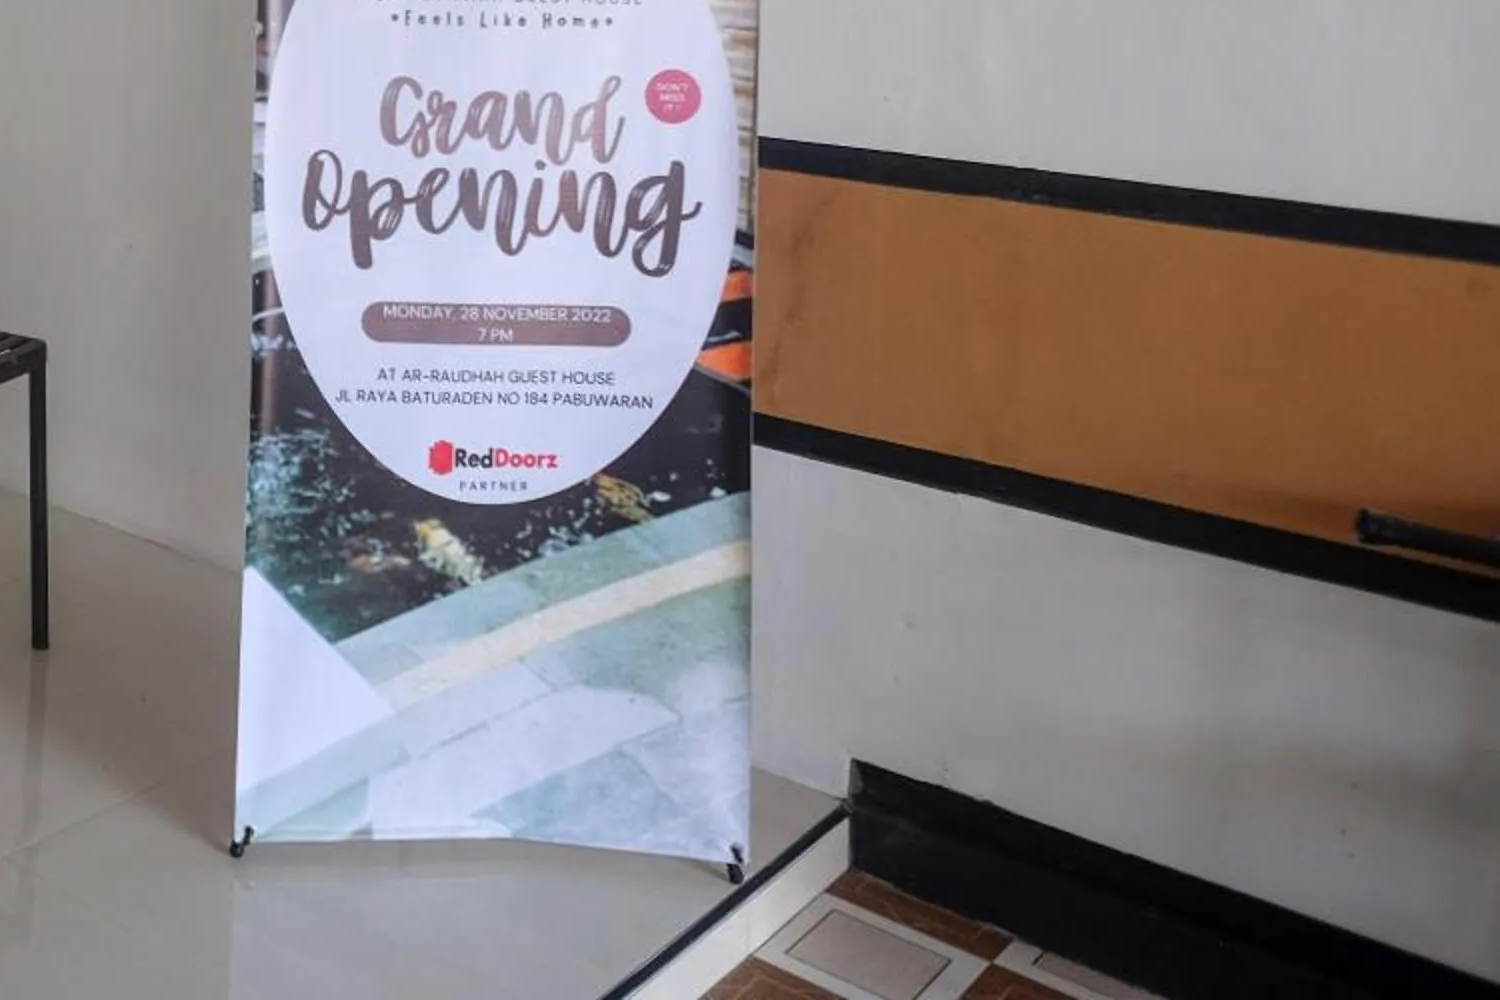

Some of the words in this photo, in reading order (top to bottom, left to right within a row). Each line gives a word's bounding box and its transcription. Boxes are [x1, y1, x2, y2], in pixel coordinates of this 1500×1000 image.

[479, 11, 527, 29] Like
[379, 75, 625, 166] Grand
[302, 149, 702, 277] Opening
[461, 307, 478, 321] 28
[483, 308, 568, 323] NOVEMBER
[572, 309, 612, 323] 2022
[478, 328, 487, 341] 7
[490, 328, 514, 342] PM
[377, 368, 396, 382] AT
[401, 369, 504, 383] AR-RAUDHAH
[508, 370, 557, 385] GUEST
[561, 371, 616, 386] HOUSE
[356, 390, 397, 403] RAYA
[402, 391, 493, 405] BATURADEN
[498, 392, 520, 405] NO
[525, 392, 547, 405] 184
[553, 393, 653, 409] PABUWARAN
[455, 447, 558, 468] RedDoorz
[460, 481, 527, 492] PARTNER
